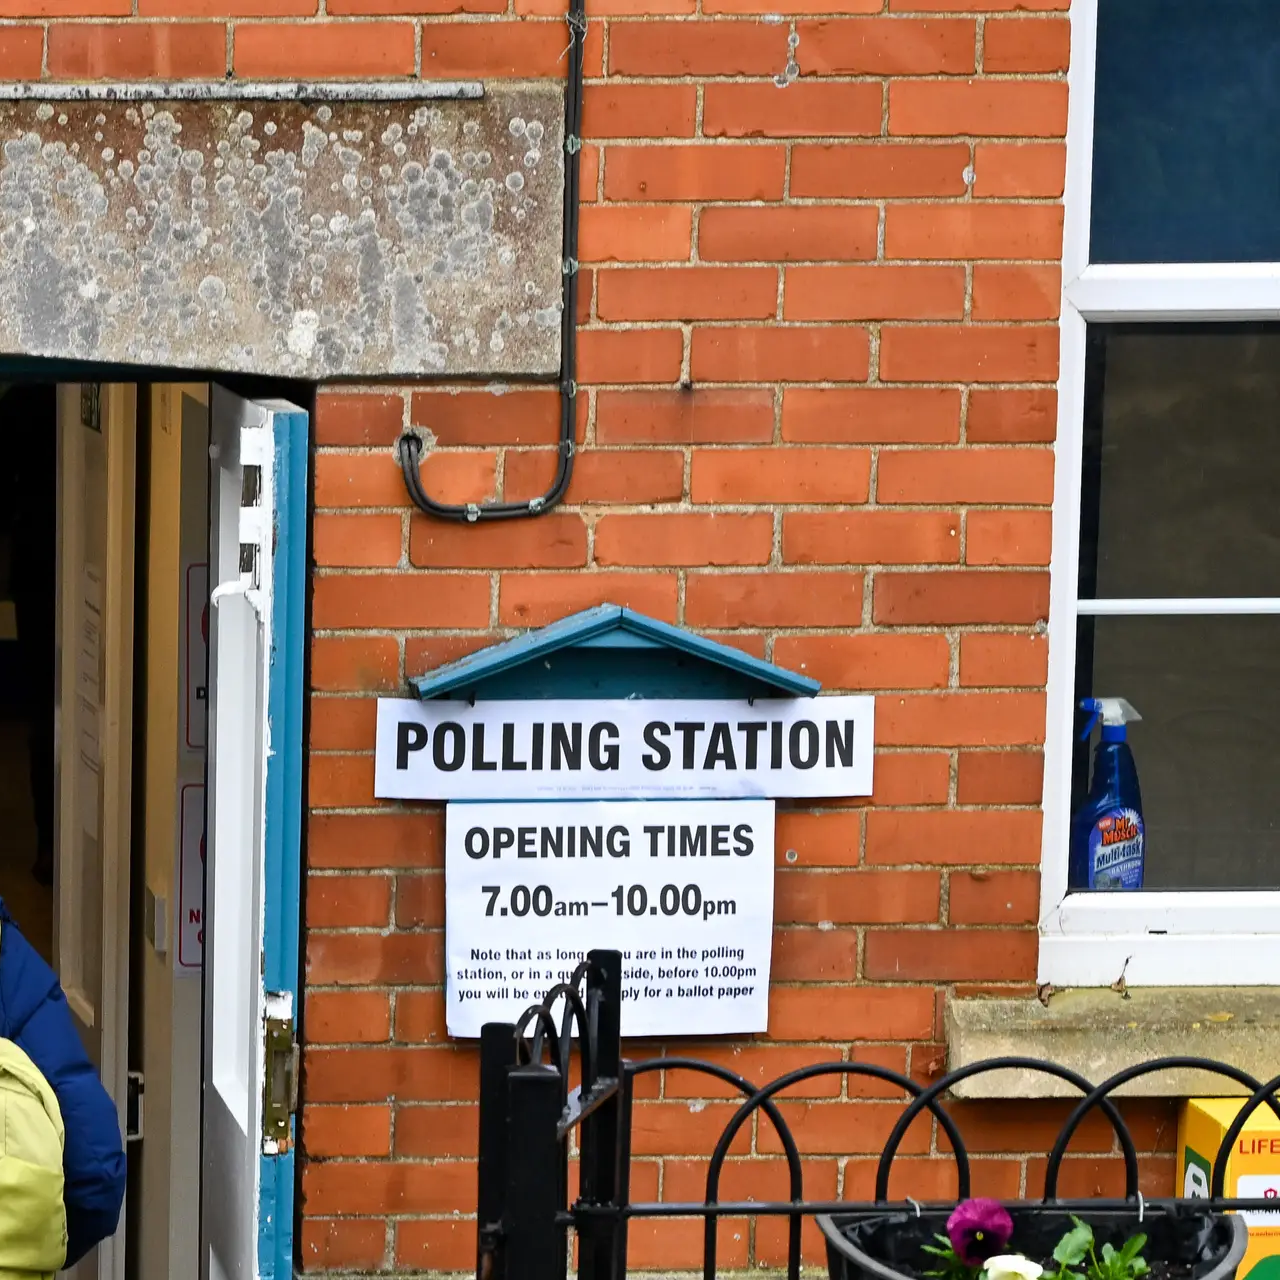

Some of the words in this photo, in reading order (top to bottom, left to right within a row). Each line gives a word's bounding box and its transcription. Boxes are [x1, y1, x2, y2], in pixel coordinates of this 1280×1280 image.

[395, 721, 620, 772] POLLING
[641, 719, 855, 771] STATION
[463, 825, 631, 860] OPENING
[643, 823, 754, 857] TIMES
[470, 948, 501, 961] Note
[505, 948, 532, 961] that
[536, 950, 552, 960] as
[556, 948, 585, 963] long
[635, 950, 657, 960] are
[661, 947, 673, 959] in
[677, 946, 698, 959] the
[701, 946, 745, 961] polling
[456, 967, 507, 981] station,
[511, 969, 525, 980] or
[528, 967, 541, 980] in
[545, 969, 553, 980] a
[622, 966, 654, 981] side,
[657, 966, 699, 979] before
[703, 965, 757, 980] 10.00pm
[458, 989, 482, 1002] you
[486, 987, 509, 999] will
[513, 987, 529, 999] be
[621, 985, 640, 1001] ply
[644, 985, 662, 998] for
[665, 987, 673, 998] a
[677, 984, 714, 998] ballot
[717, 985, 755, 999] paper
